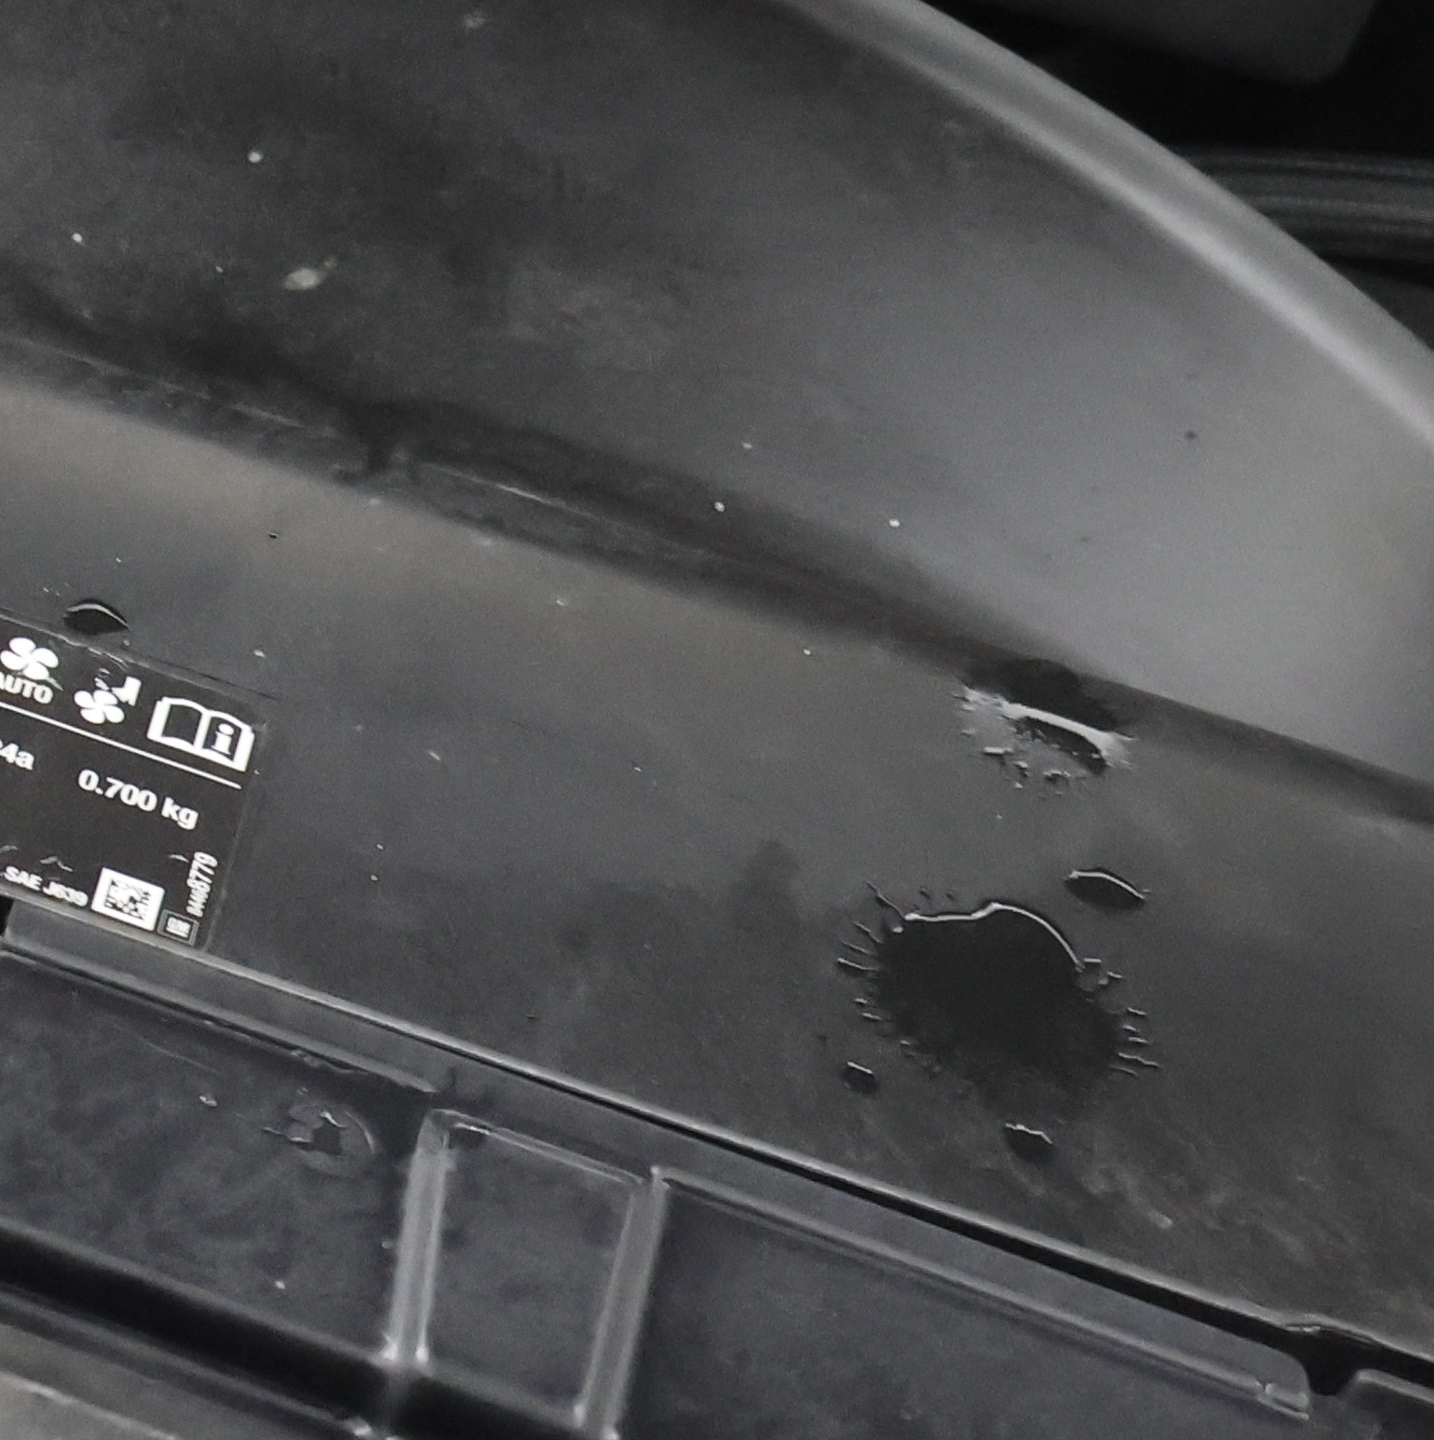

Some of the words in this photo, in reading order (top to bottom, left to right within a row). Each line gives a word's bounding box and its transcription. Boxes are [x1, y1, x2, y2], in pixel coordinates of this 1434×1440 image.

[78, 769, 157, 812] 0.700
[162, 797, 199, 830] kg
[5, 866, 42, 891] SAE
